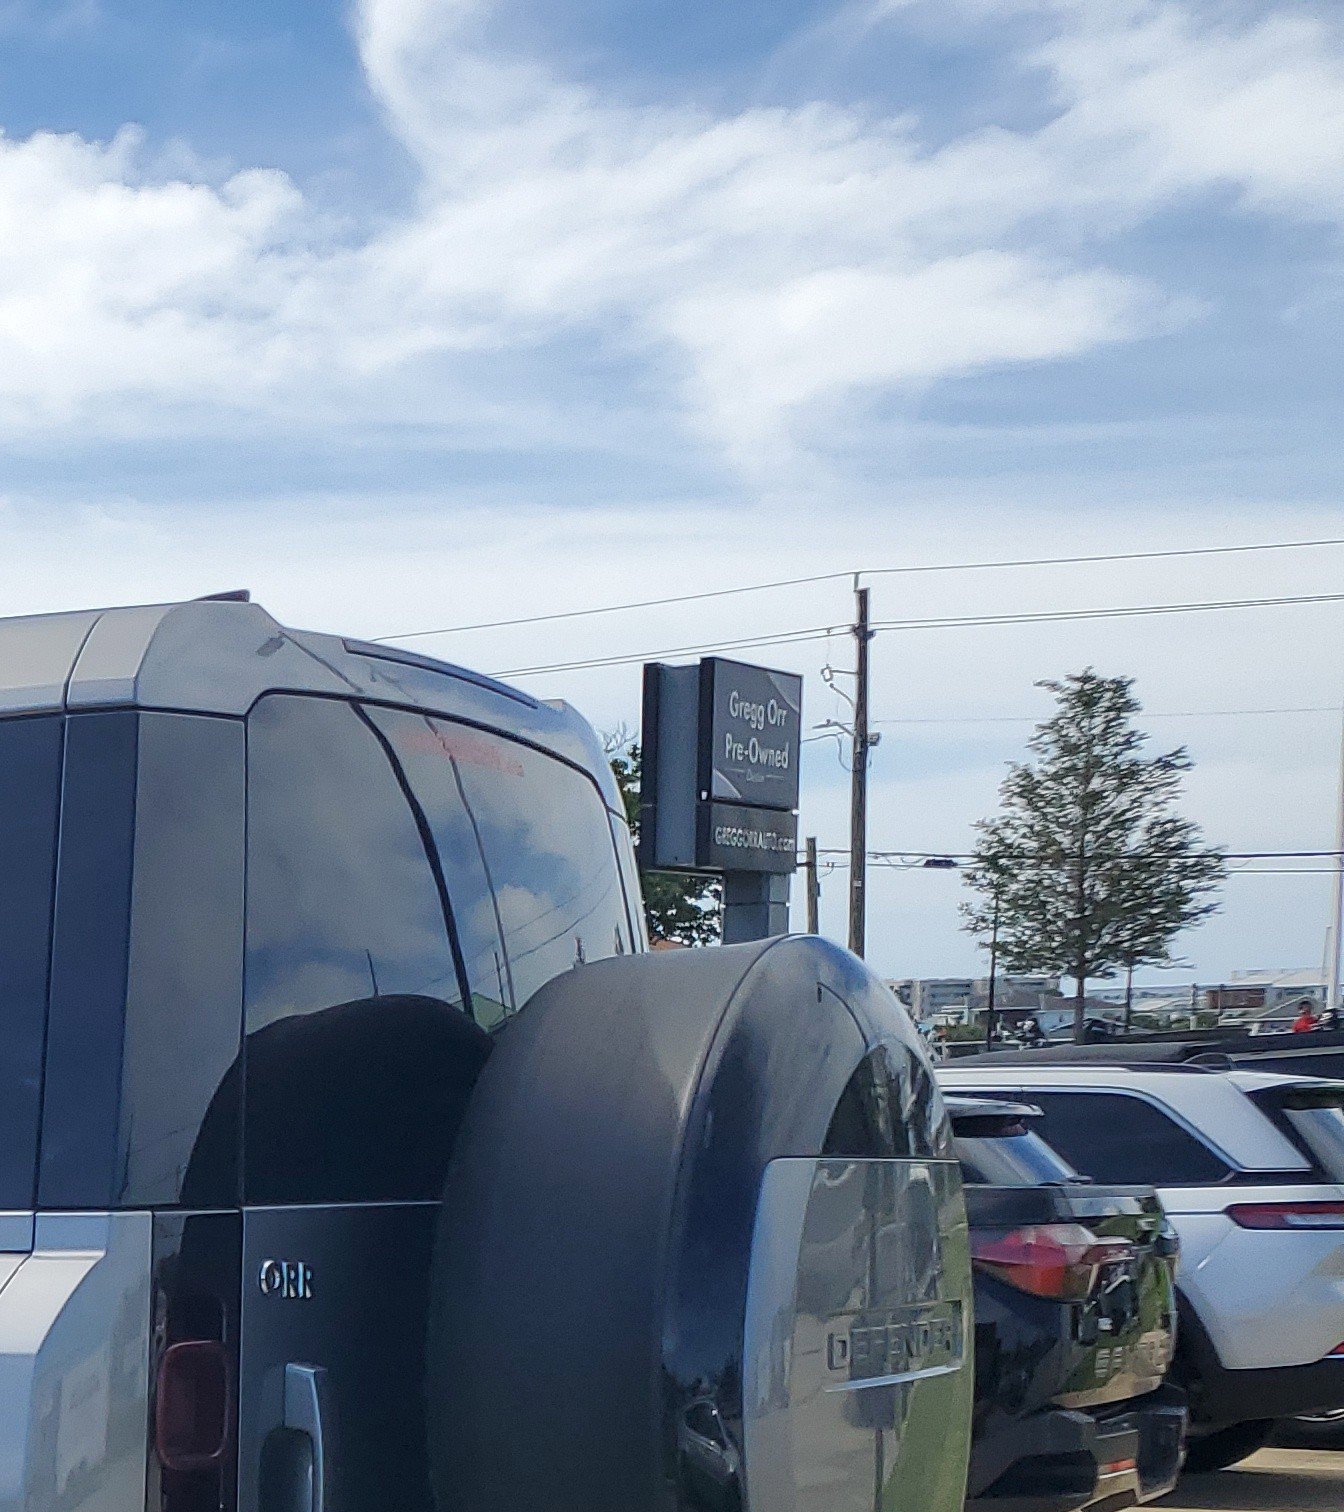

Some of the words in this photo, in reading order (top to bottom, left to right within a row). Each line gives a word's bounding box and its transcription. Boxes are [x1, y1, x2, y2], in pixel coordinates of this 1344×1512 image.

[729, 690, 764, 730] Gregg
[767, 699, 788, 727] Orr
[725, 733, 789, 769] Pre-Owned
[259, 1259, 313, 1299] ORR
